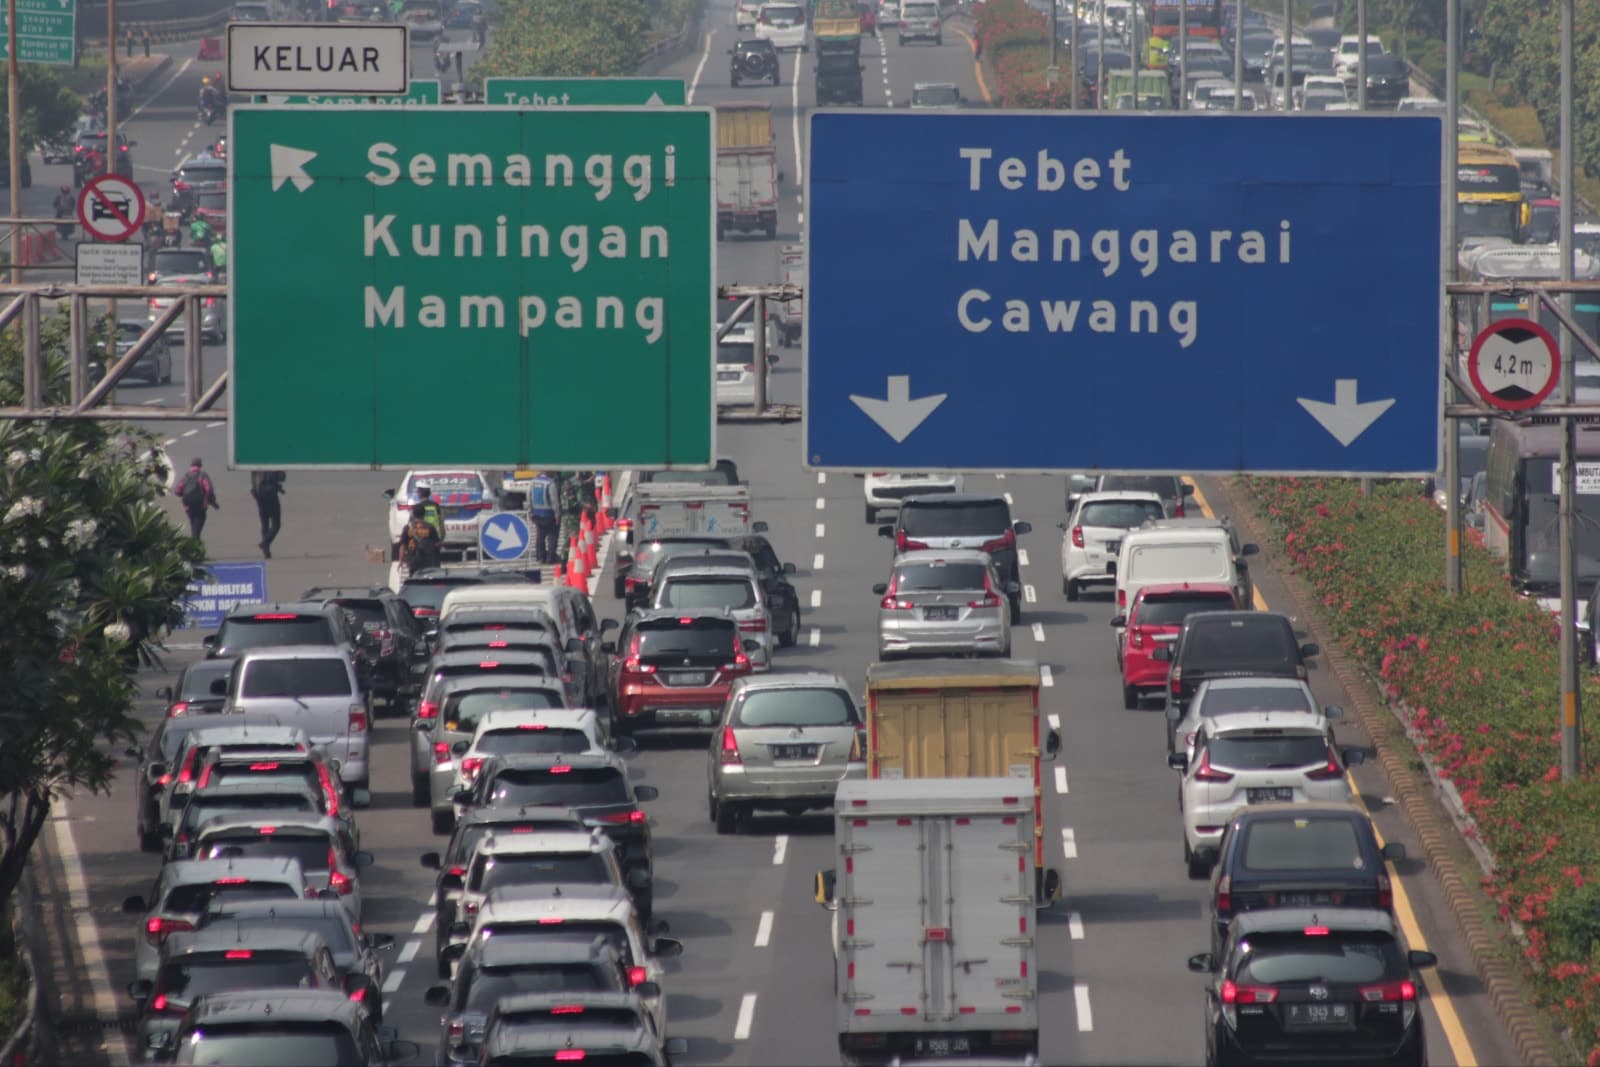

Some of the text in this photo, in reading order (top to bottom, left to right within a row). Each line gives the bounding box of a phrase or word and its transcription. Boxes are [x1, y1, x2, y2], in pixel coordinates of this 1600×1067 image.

[253, 45, 380, 72] KELUAR
[365, 142, 676, 201] Semanggi
[959, 147, 1131, 191] Tebet
[363, 214, 669, 273] Kuningan
[958, 219, 1291, 277] Manggarai
[364, 285, 664, 344] Mampang
[957, 288, 1198, 348] Cawang
[1494, 354, 1533, 378] 4,2 m
[201, 583, 254, 596] MOBILITAS
